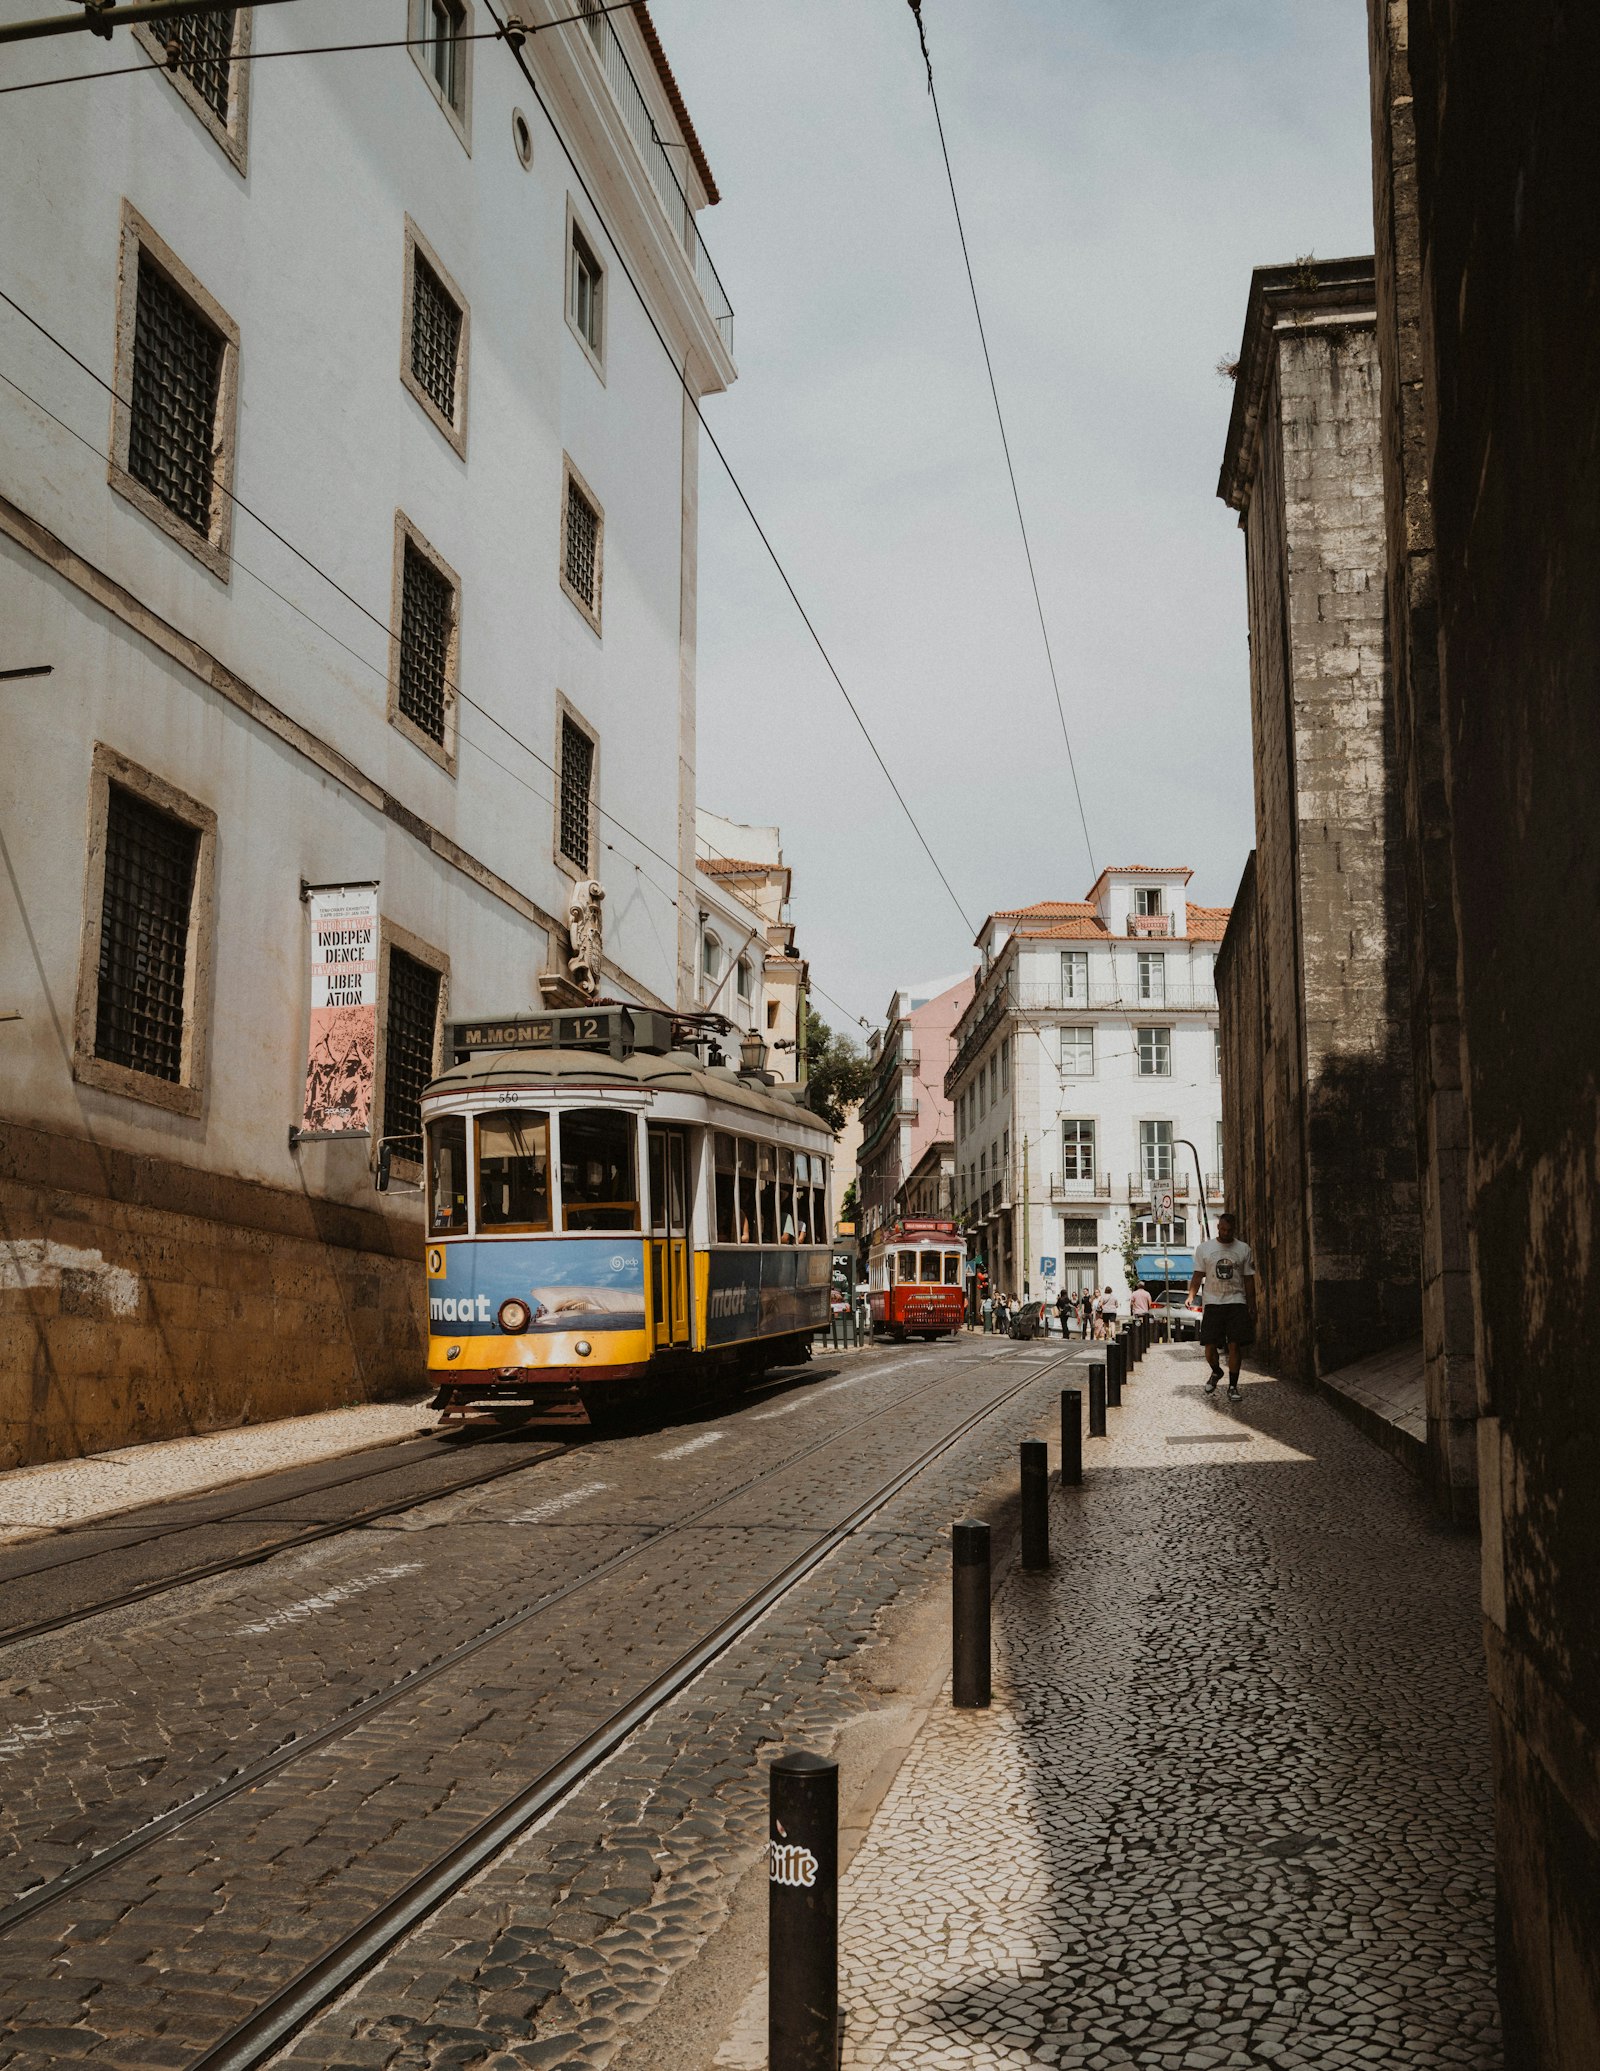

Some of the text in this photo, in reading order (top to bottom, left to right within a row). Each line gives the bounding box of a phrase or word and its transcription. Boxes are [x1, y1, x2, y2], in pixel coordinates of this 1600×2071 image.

[316, 919, 345, 931] BEFORE
[356, 916, 372, 928] WAS
[318, 929, 371, 946] INDEPEN
[326, 947, 365, 964] DENCE
[321, 963, 340, 974] WAS
[328, 974, 362, 990] LIBER
[326, 990, 362, 1007] ATION
[466, 1019, 598, 1044] M.MONIZ 12
[498, 1092, 519, 1103] 550
[832, 1256, 848, 1266] FC
[430, 1294, 491, 1322] maat
[710, 1280, 747, 1319] maat
